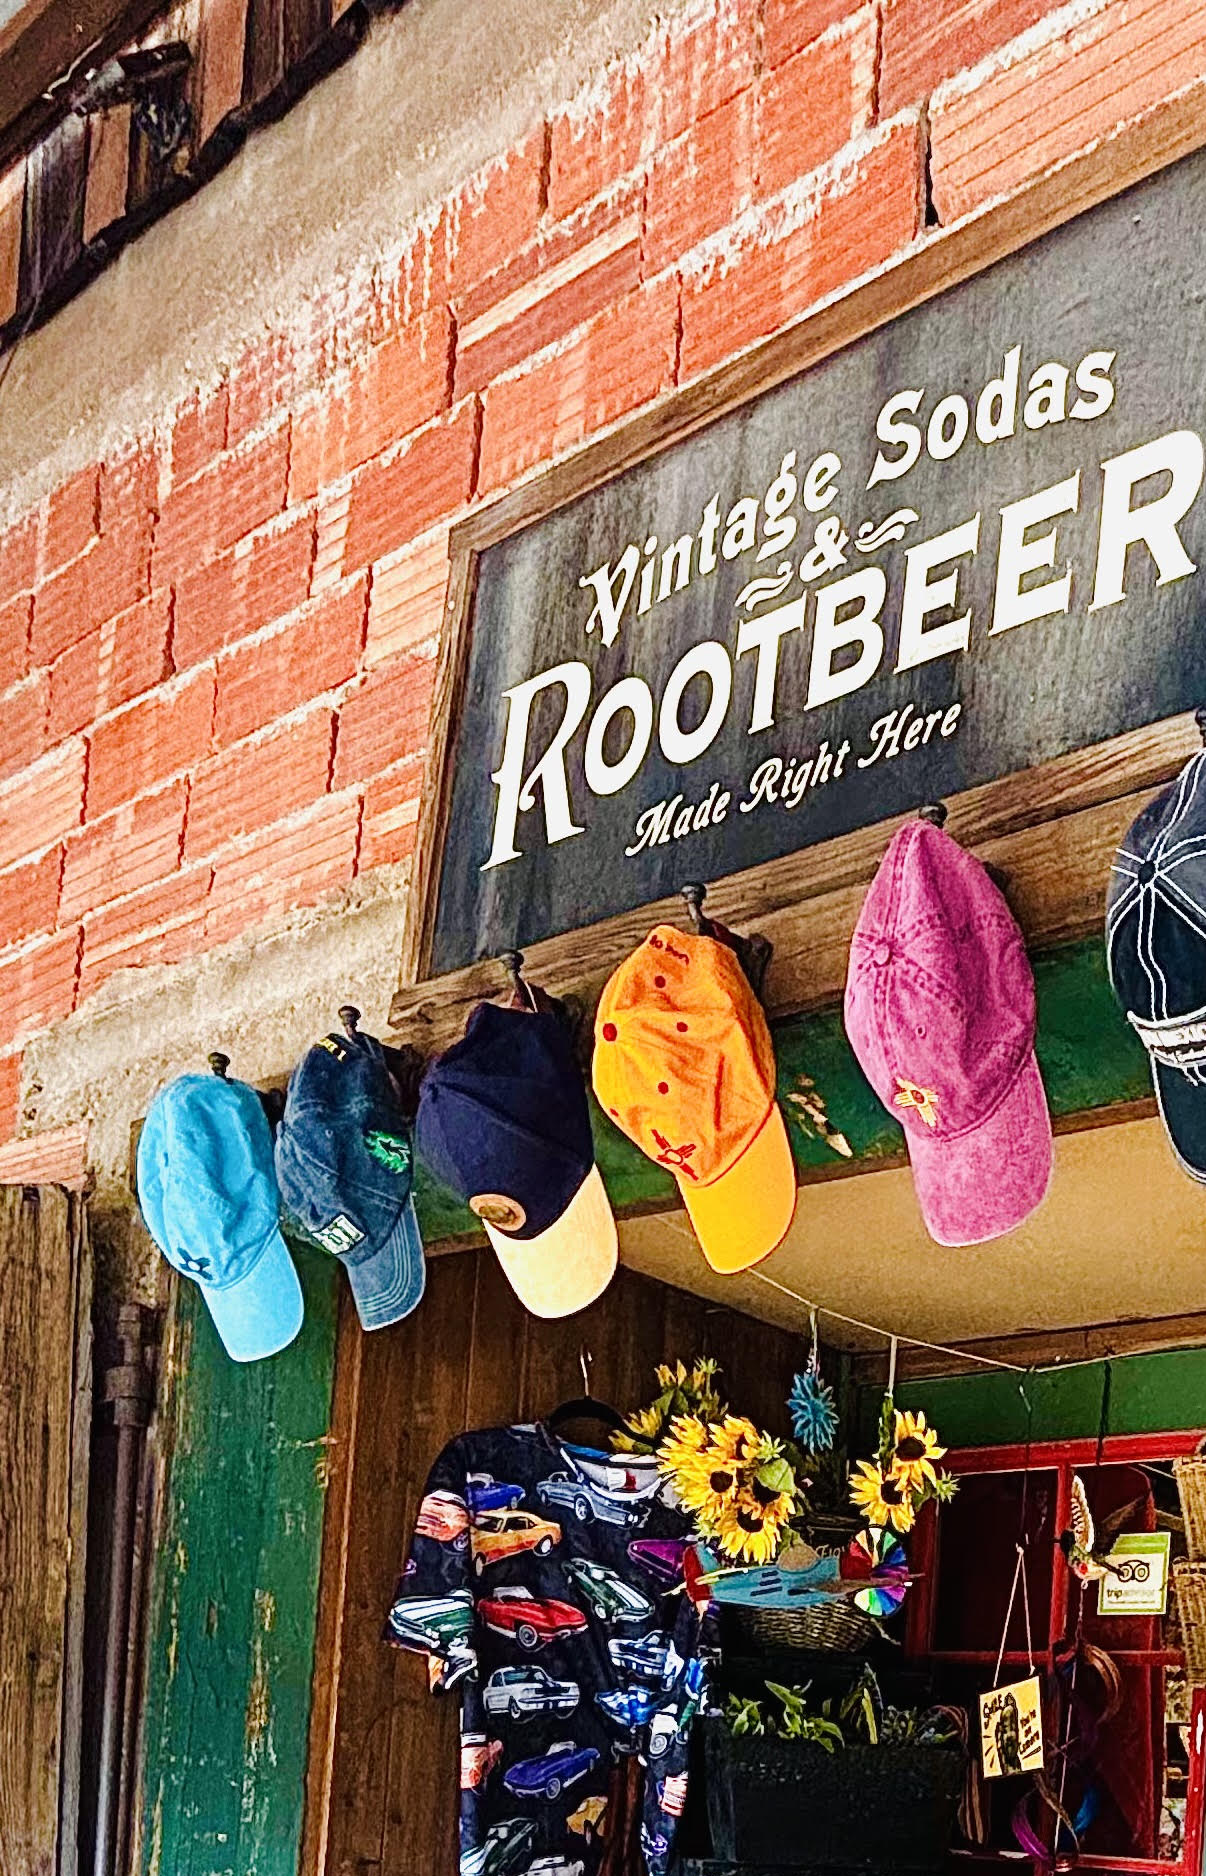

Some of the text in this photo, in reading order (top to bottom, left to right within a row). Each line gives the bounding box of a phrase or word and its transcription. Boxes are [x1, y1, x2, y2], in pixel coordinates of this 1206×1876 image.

[578, 344, 1117, 649] Vintage Sodas
[799, 516, 849, 582] &
[479, 430, 1205, 872] ROOTBEER
[624, 703, 962, 858] Made Right Here
